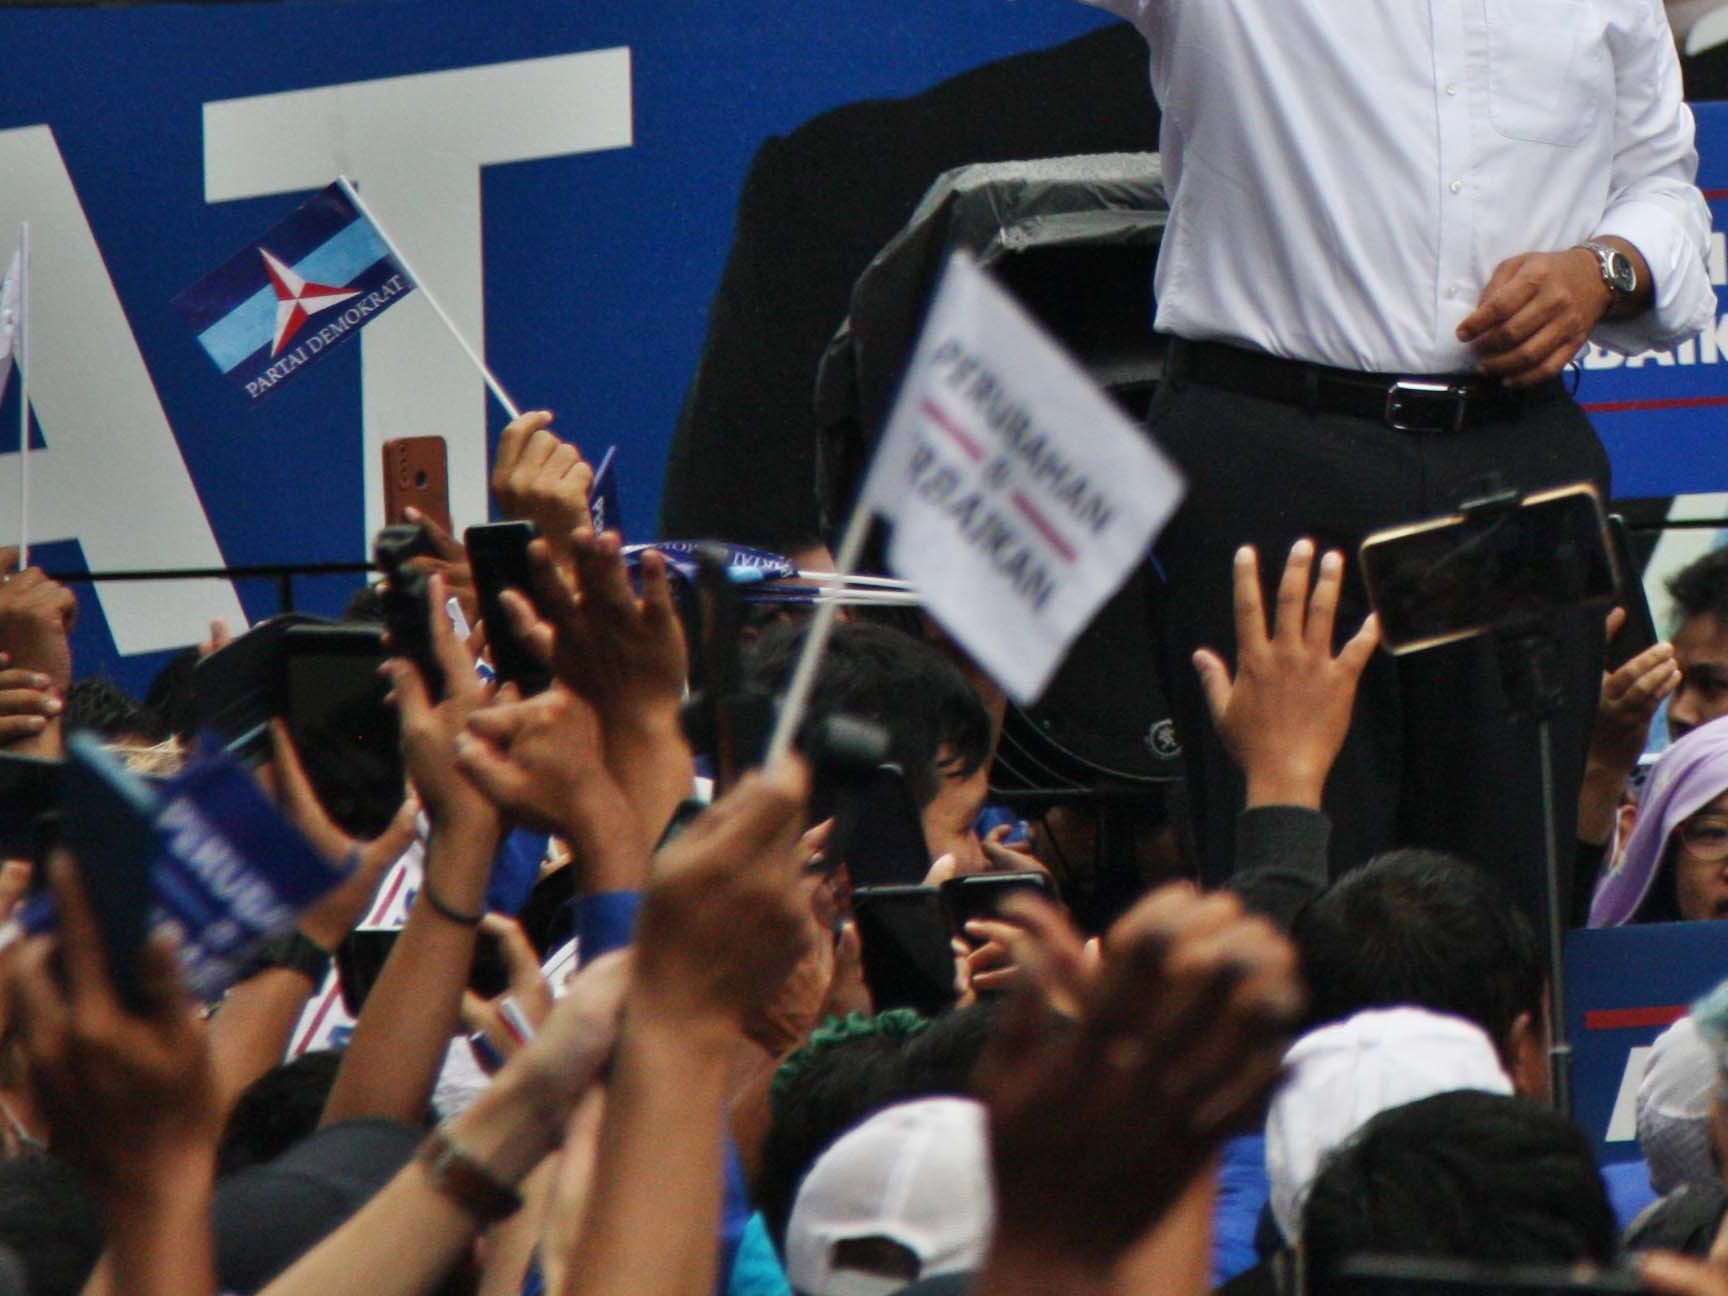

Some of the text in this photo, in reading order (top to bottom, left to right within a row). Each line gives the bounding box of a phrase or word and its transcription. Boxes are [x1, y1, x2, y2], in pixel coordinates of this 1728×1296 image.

[245, 274, 404, 398] PARTAI DEMOKRAT
[932, 337, 1119, 536] PERUBAHAN
